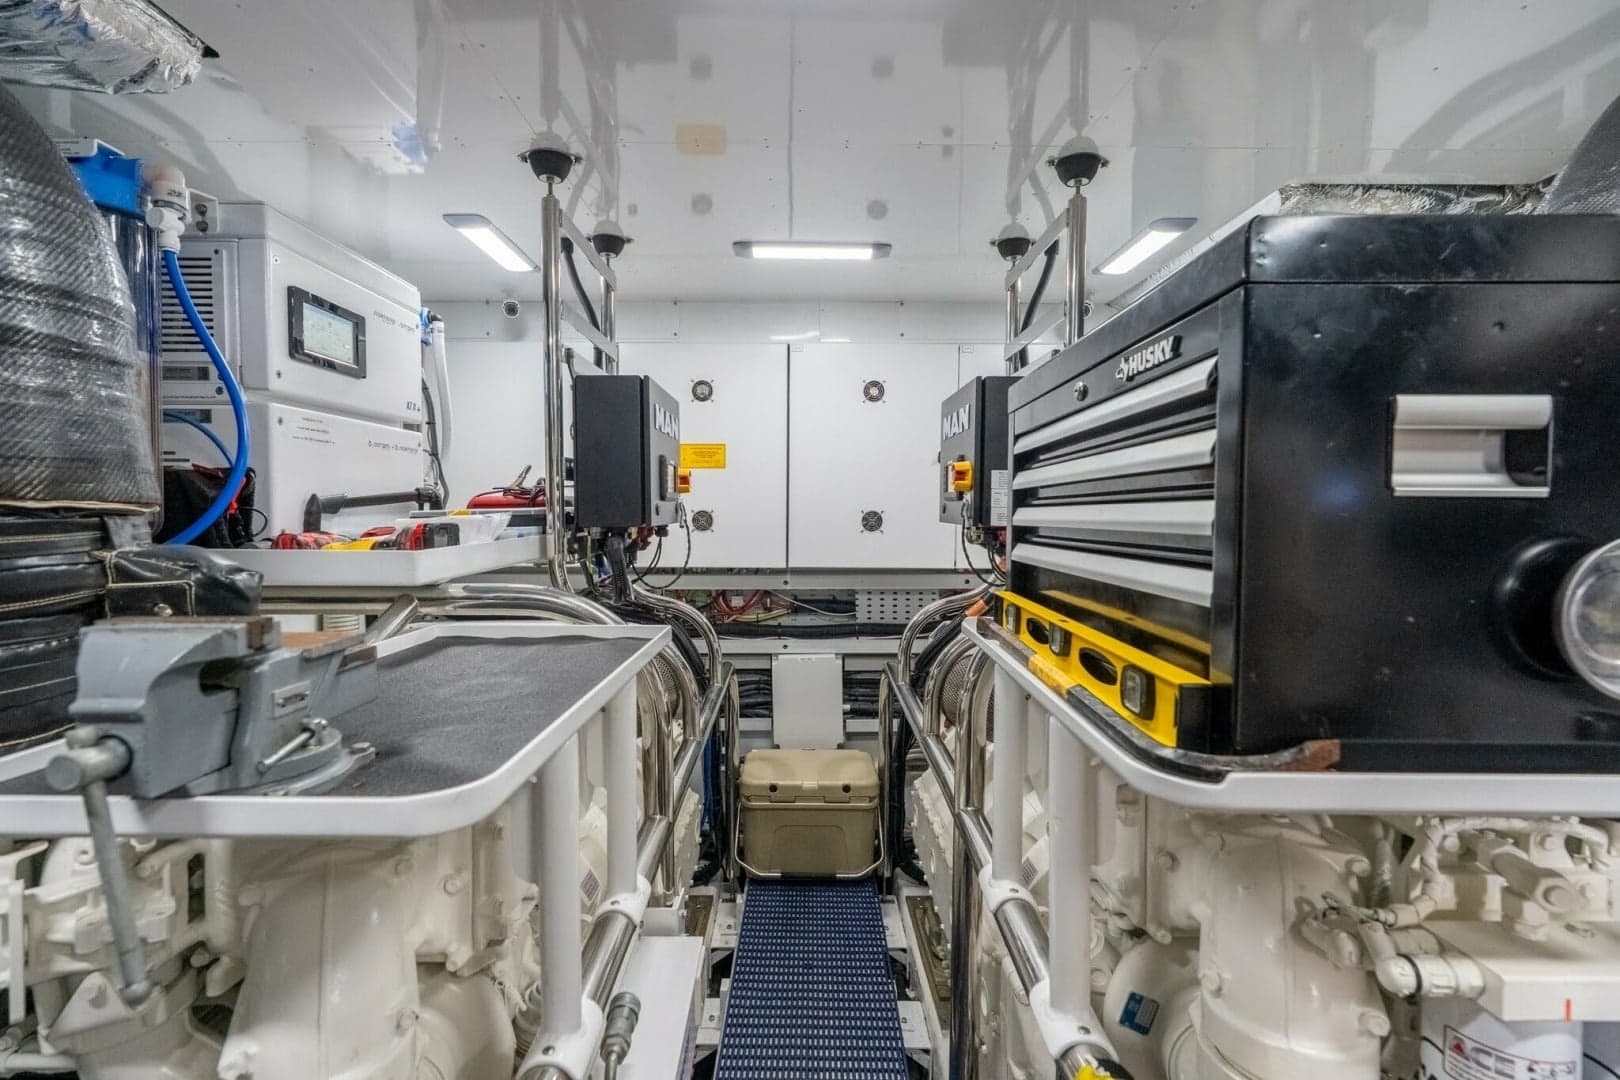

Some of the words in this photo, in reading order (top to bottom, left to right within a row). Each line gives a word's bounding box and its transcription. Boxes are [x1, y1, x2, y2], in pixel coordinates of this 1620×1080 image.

[1128, 336, 1174, 377] HUSKY
[655, 403, 679, 441] MAN
[943, 403, 970, 440] MAN
